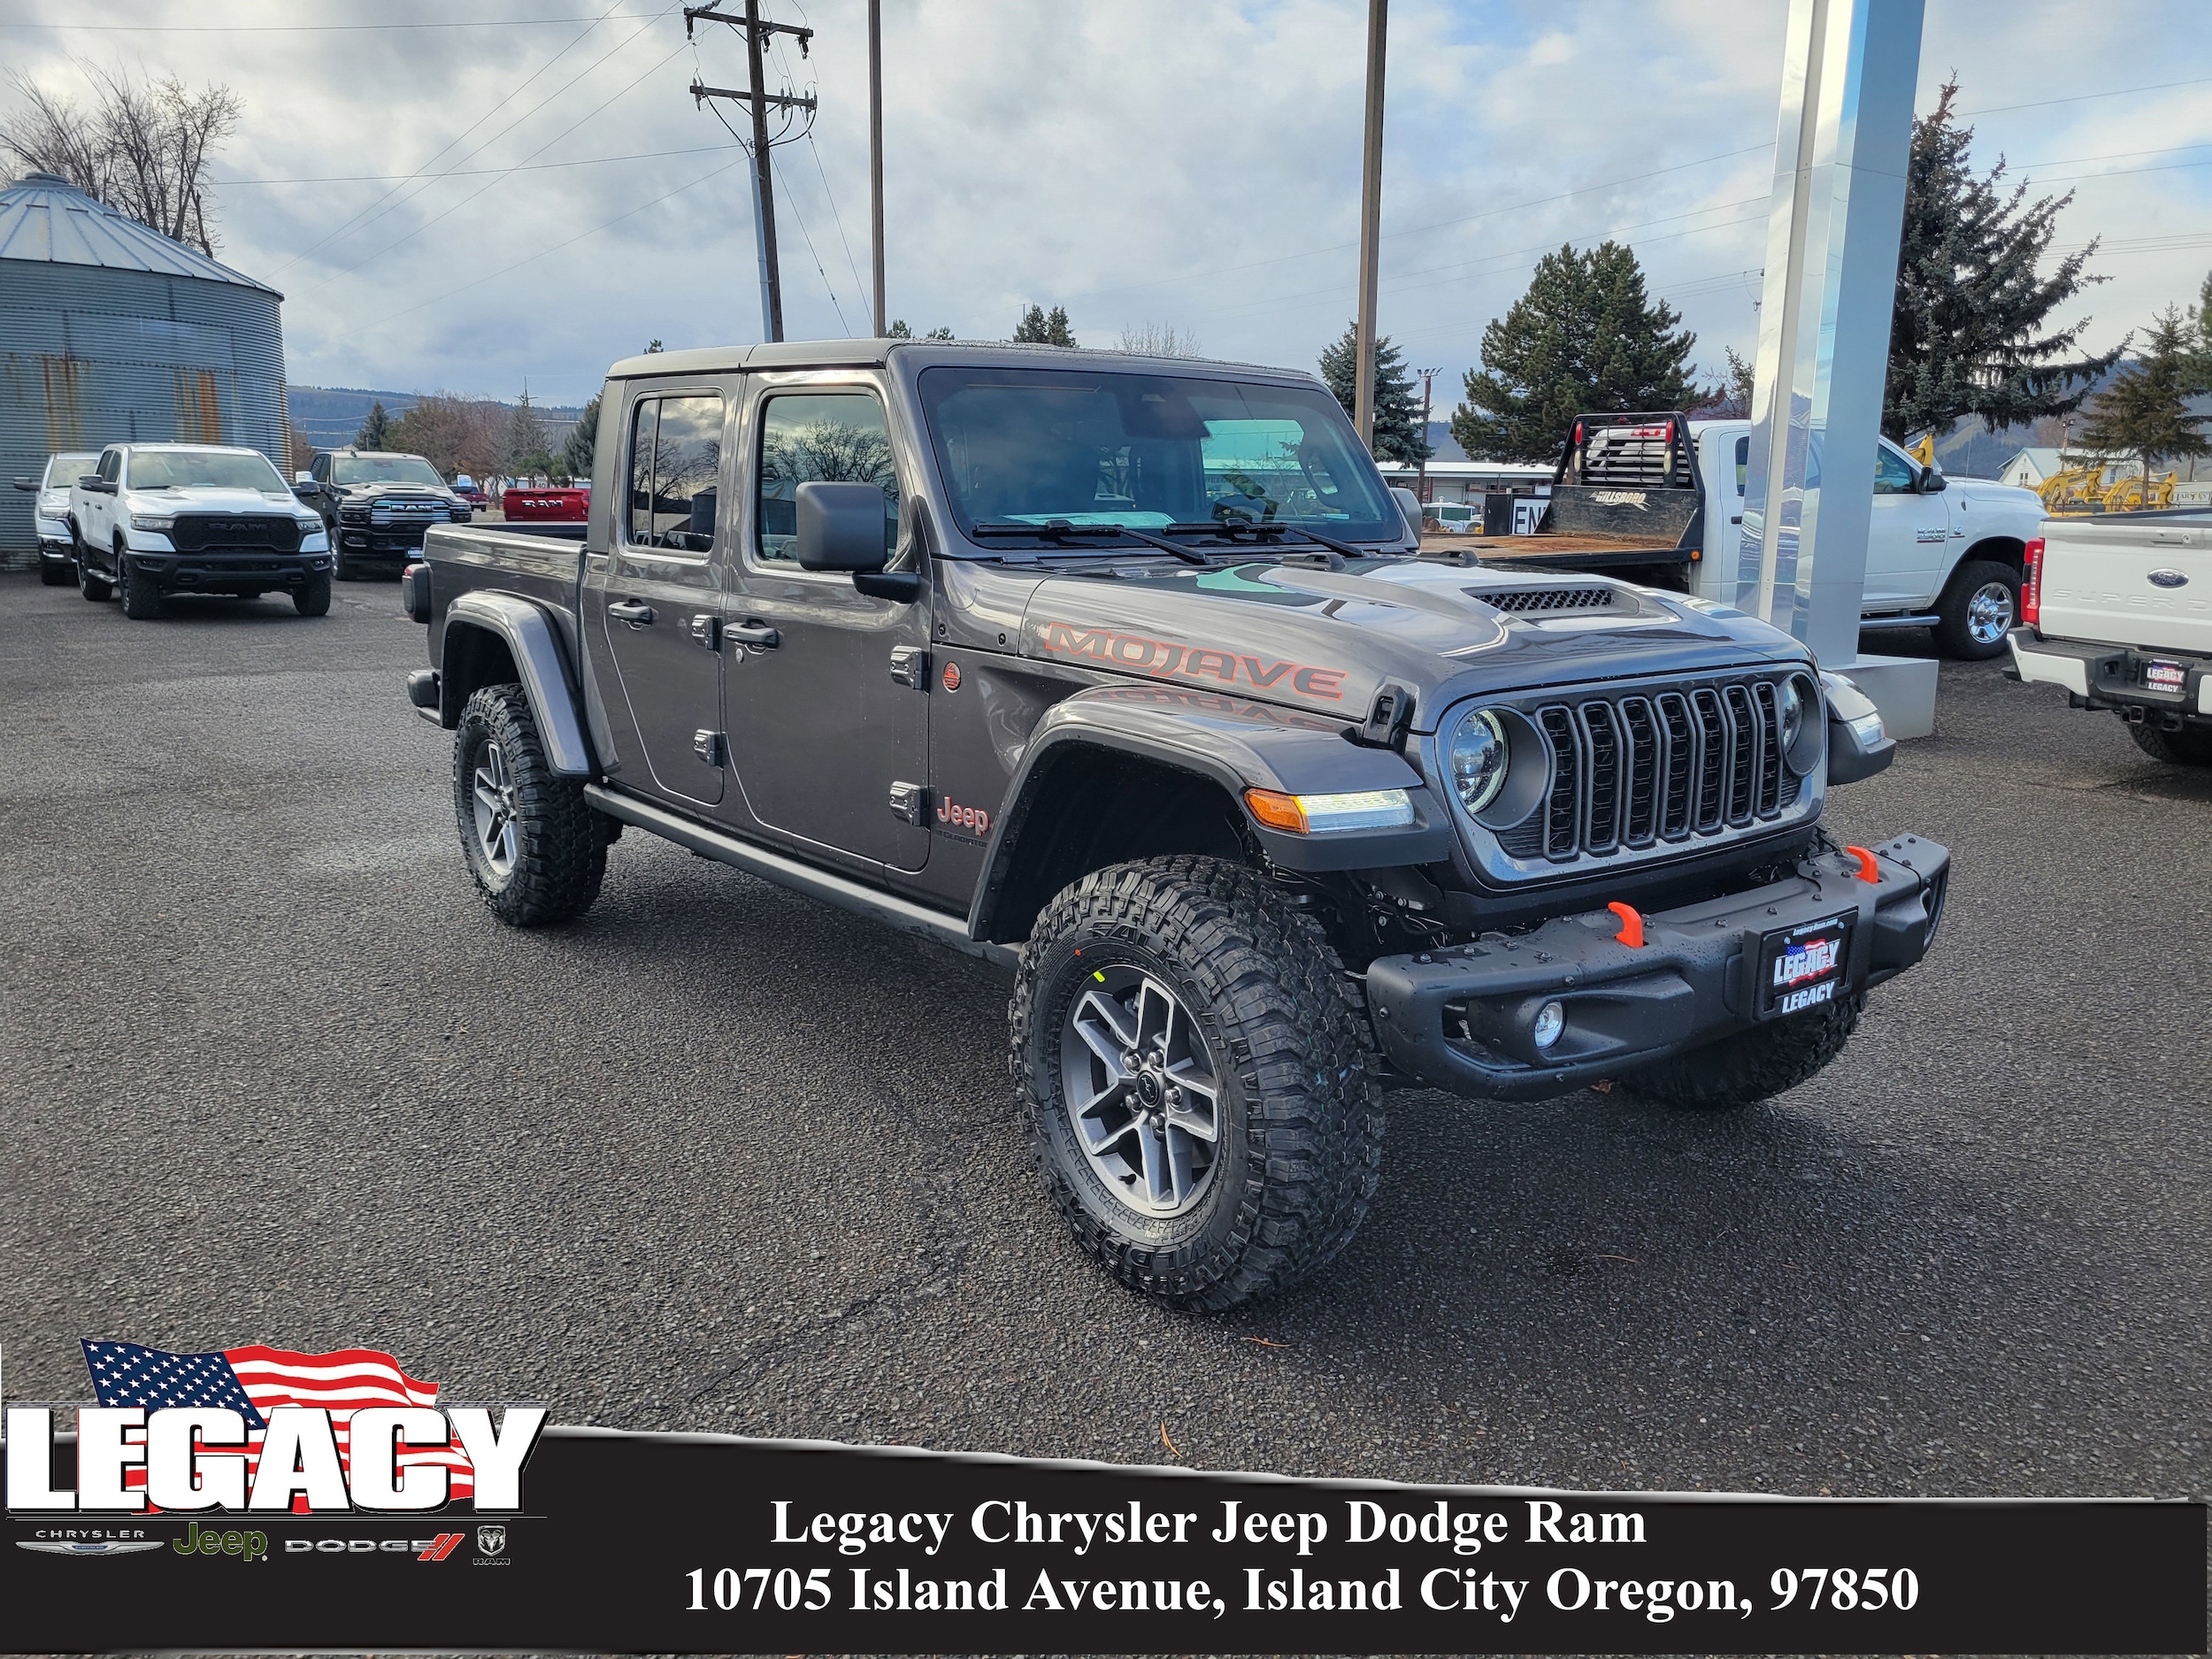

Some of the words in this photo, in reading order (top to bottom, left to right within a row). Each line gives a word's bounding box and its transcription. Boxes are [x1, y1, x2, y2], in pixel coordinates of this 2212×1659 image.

[522, 499, 563, 508] RAM
[1595, 491, 1647, 503] HILLSBORO
[2053, 588, 2175, 609] SUPER
[1046, 622, 1348, 701] MOJAVE
[2147, 667, 2185, 682] LEGACY
[2148, 682, 2178, 693] LEGACY
[937, 796, 989, 836] Jeep
[1774, 941, 1840, 984] LEGACY
[1782, 981, 1835, 1014] LEGACY
